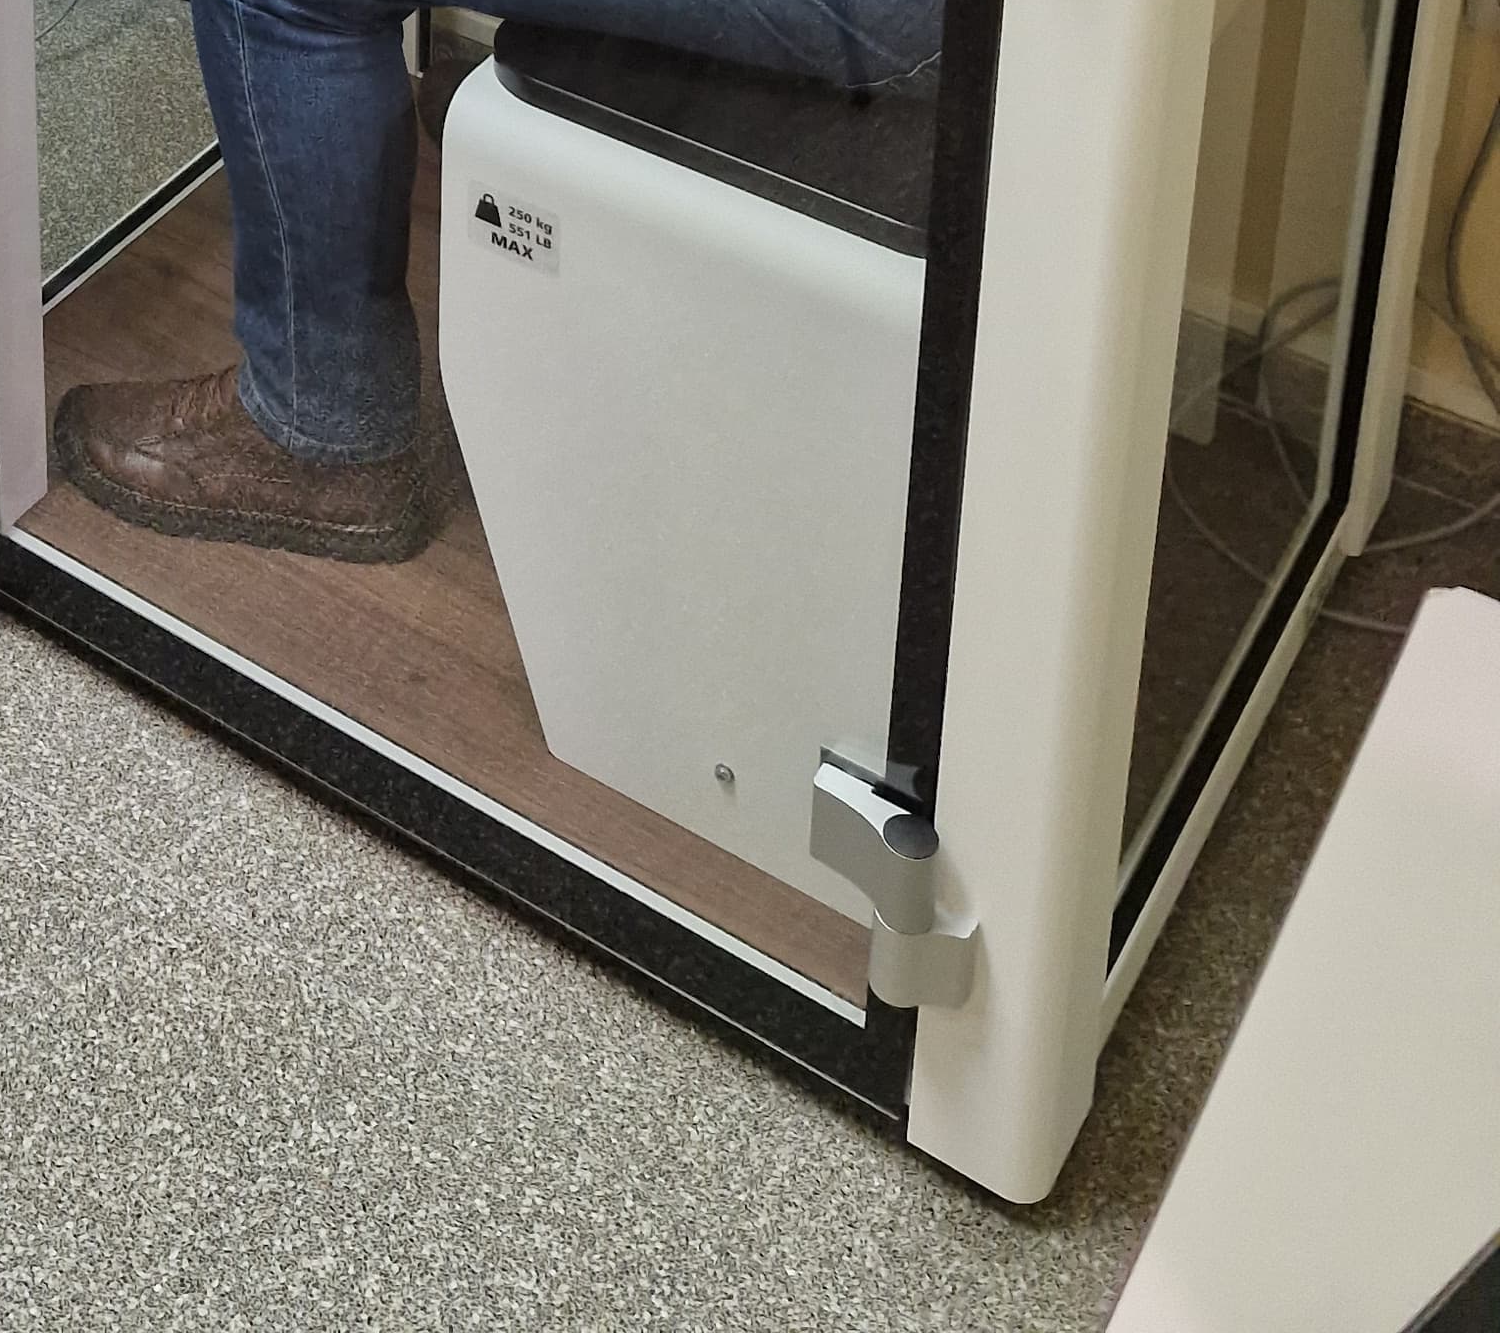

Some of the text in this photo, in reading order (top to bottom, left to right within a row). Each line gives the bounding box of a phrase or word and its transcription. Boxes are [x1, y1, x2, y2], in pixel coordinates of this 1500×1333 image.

[508, 206, 553, 235] 250 kg
[491, 231, 534, 261] MAX
[509, 223, 552, 249] 551 LB
